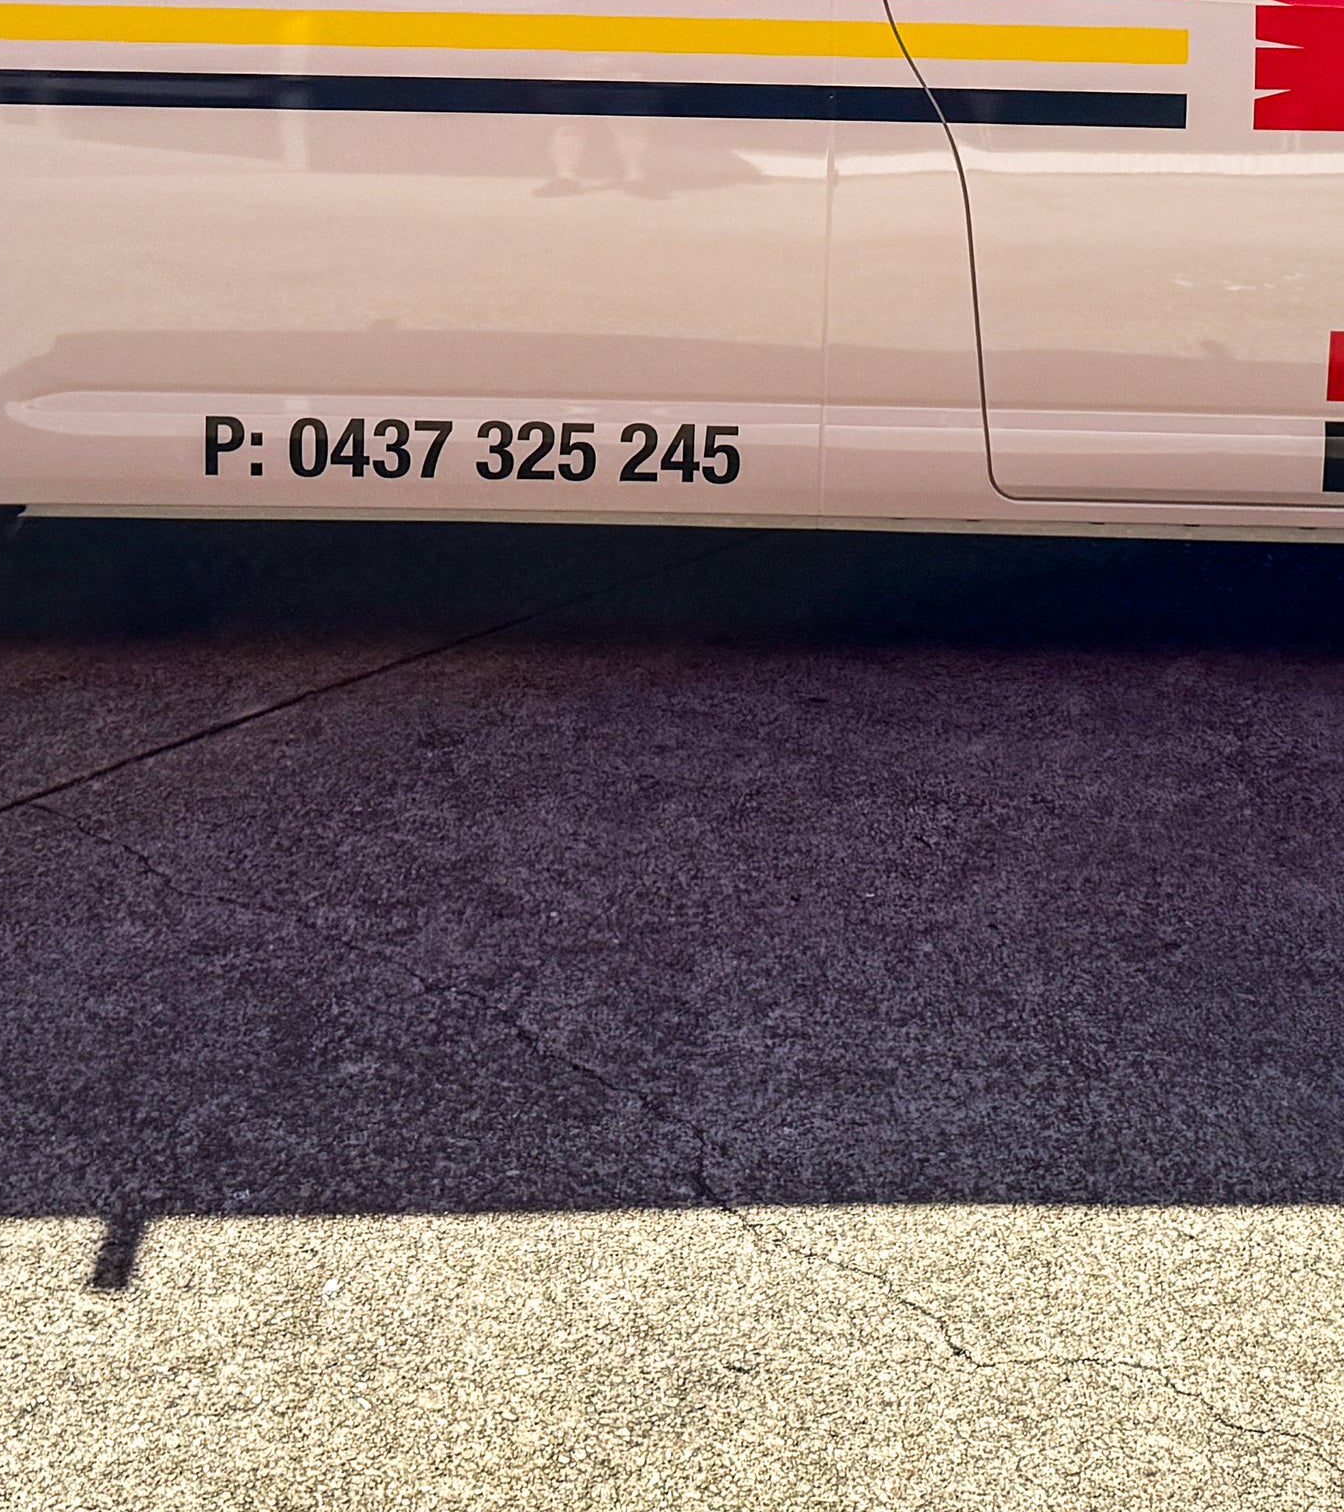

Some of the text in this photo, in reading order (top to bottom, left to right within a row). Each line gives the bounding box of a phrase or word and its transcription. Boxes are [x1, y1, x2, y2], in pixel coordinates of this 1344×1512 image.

[204, 416, 741, 483] P: 0437 325 245
